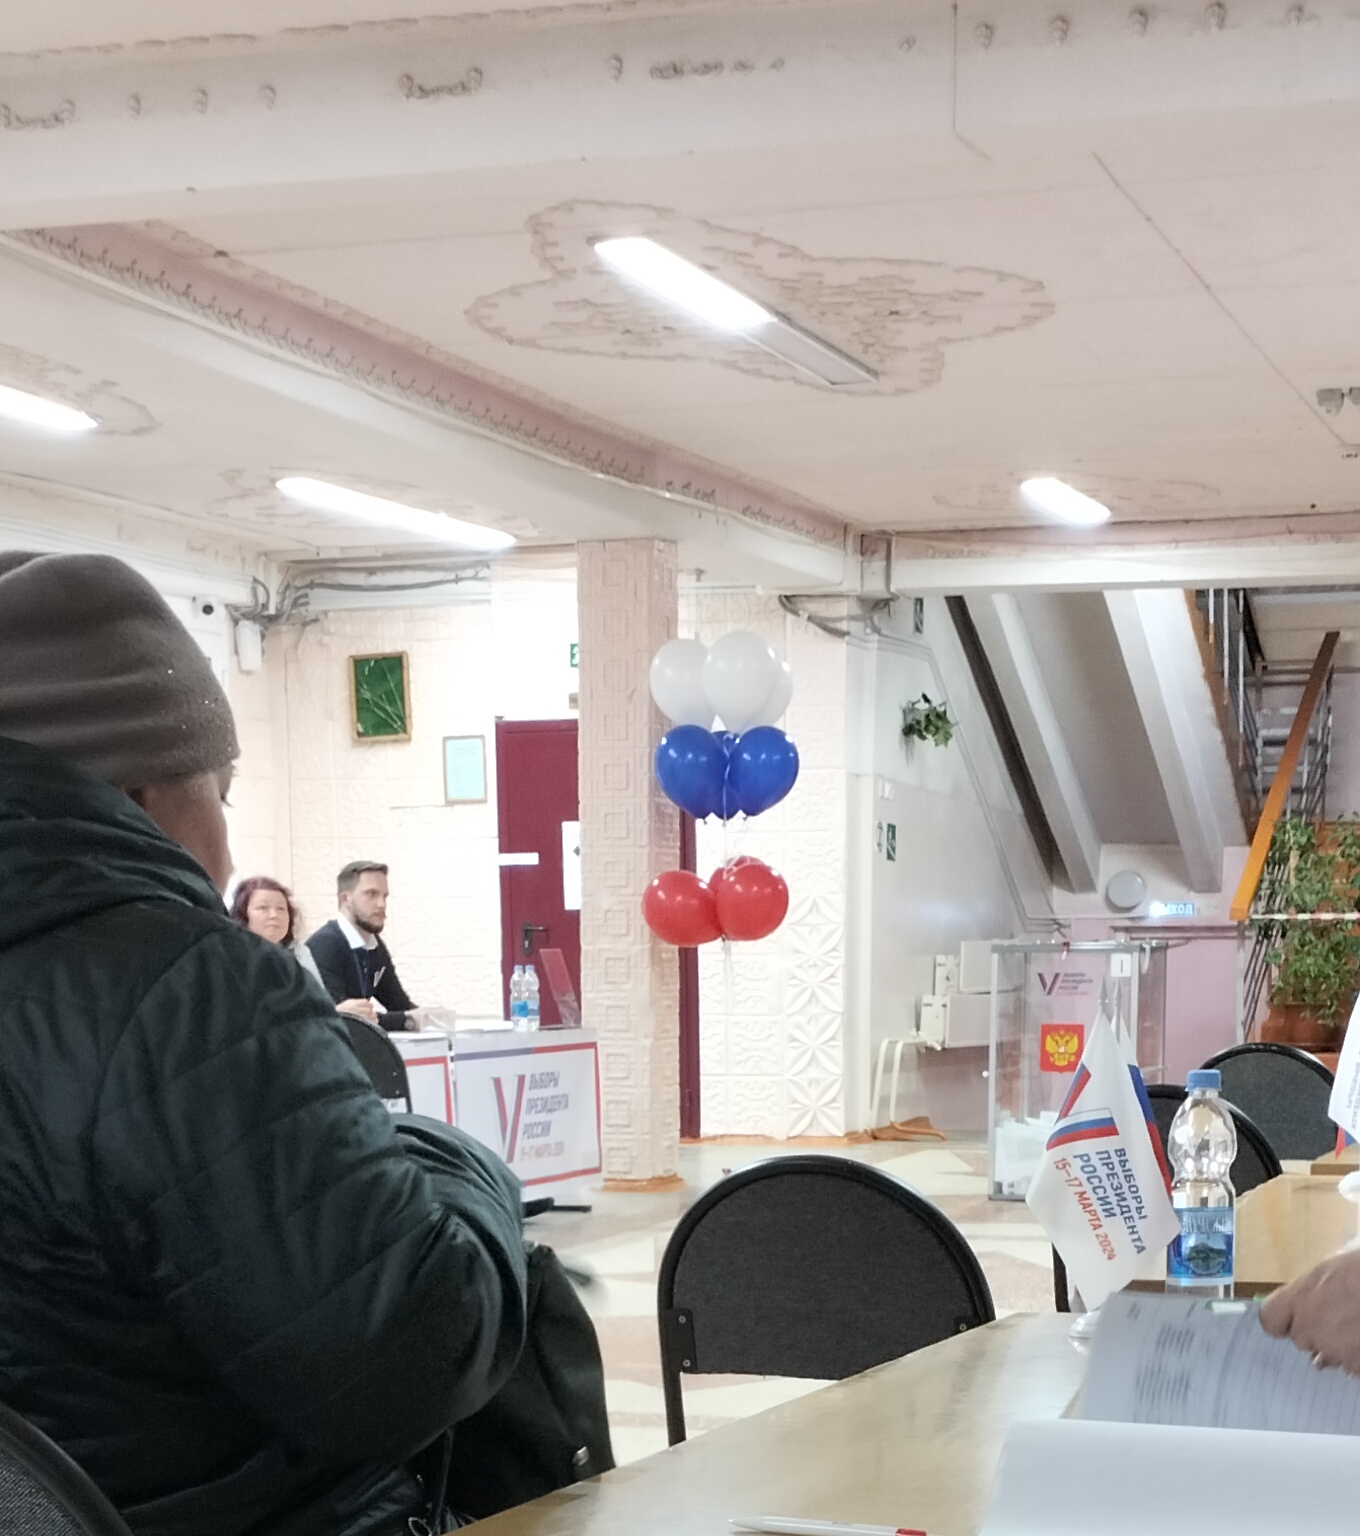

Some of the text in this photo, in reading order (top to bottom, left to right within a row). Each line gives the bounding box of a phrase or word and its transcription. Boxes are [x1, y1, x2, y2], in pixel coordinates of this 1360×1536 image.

[1151, 903, 1193, 915] ЫХОД
[1072, 1153, 1118, 1219] РОССИИ
[1095, 1150, 1146, 1255] ПРЕЗИДЕНТА
[1114, 1147, 1148, 1220] ВЫБОРЫ
[1073, 1190, 1104, 1231] МАРТА
[1095, 1232, 1117, 1261] 2024
